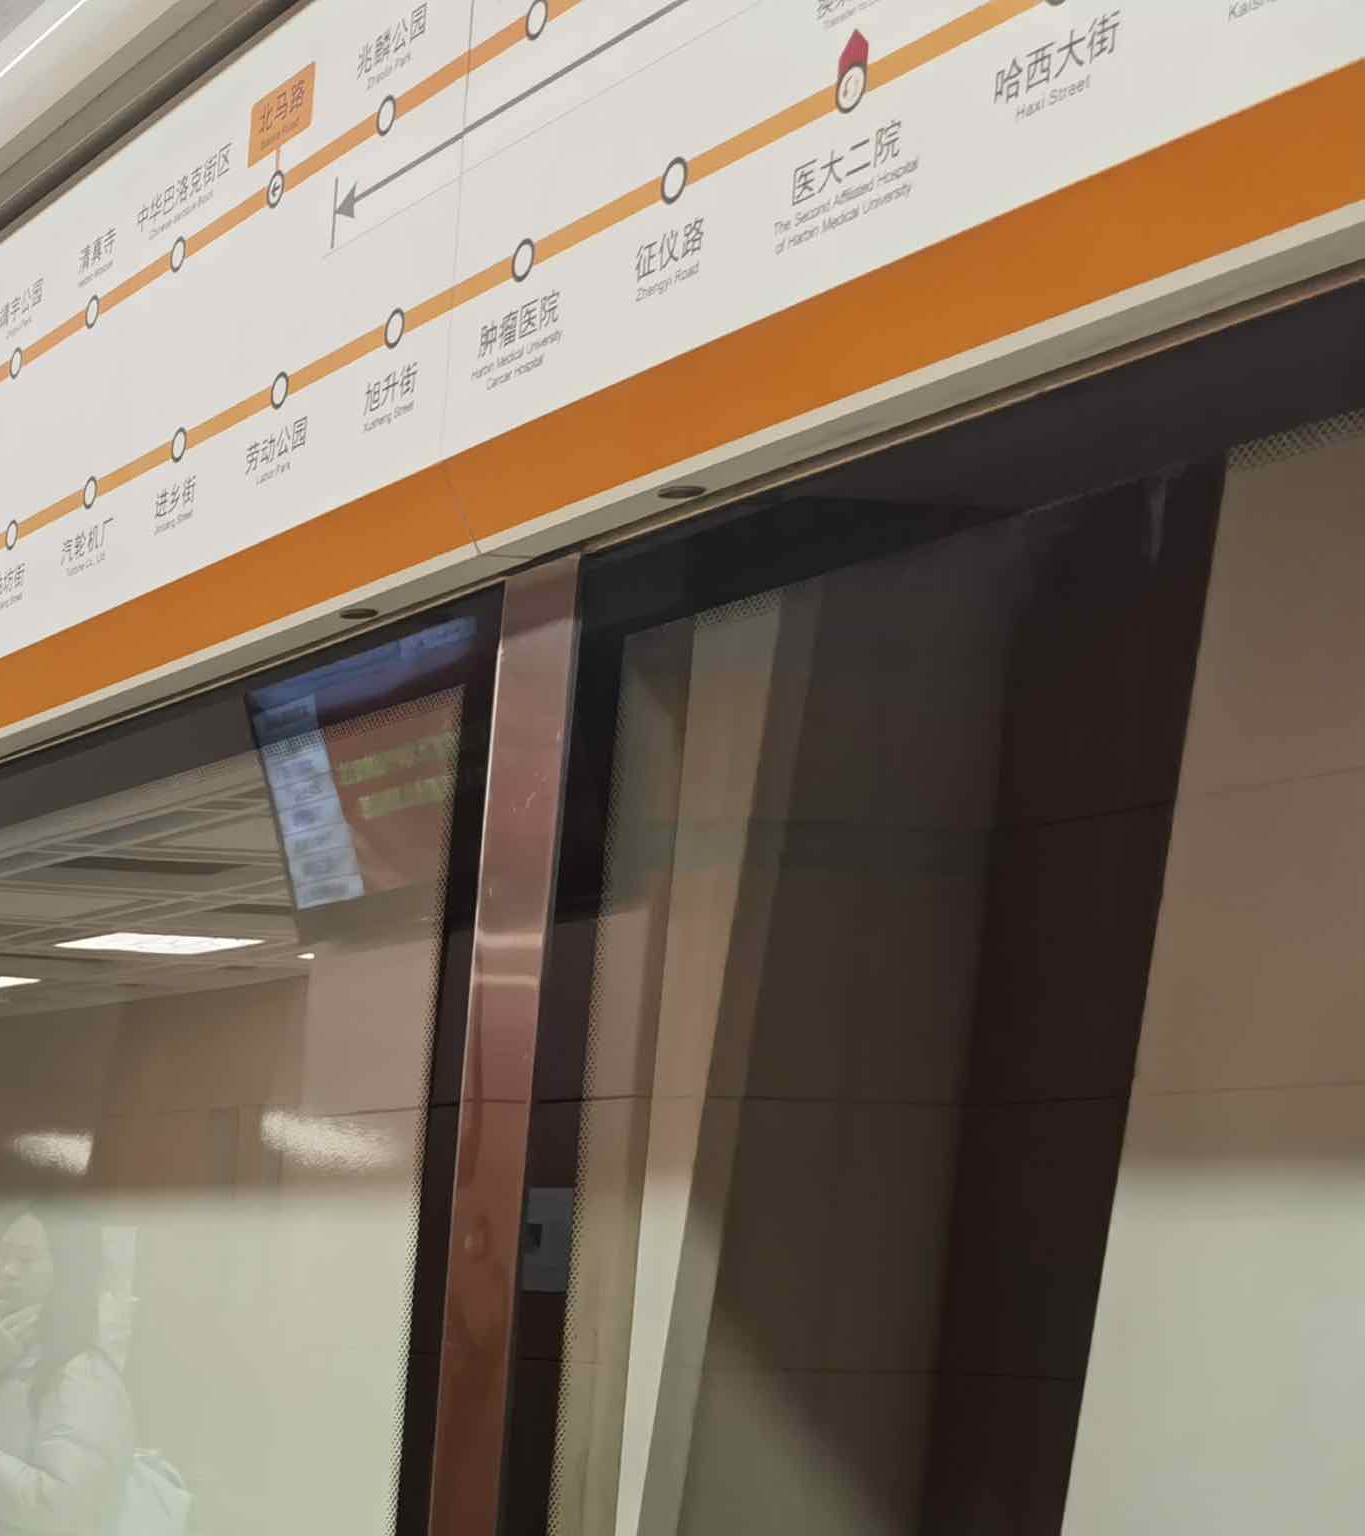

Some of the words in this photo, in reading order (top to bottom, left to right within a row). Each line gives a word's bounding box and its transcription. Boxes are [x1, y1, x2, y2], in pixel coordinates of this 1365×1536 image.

[993, 11, 1120, 105] 哈西大街
[259, 79, 306, 133] 北马路
[1015, 97, 1045, 123] Haxi
[1048, 74, 1092, 107] Street
[791, 120, 901, 206] 医大二院
[635, 217, 704, 282] 征仪路
[477, 289, 560, 359] 肿瘤医院
[363, 362, 419, 417] 旭升街
[245, 416, 309, 476] 劳动公园
[154, 475, 197, 520] 进乡街
[60, 516, 114, 566] 汽轮机厂
